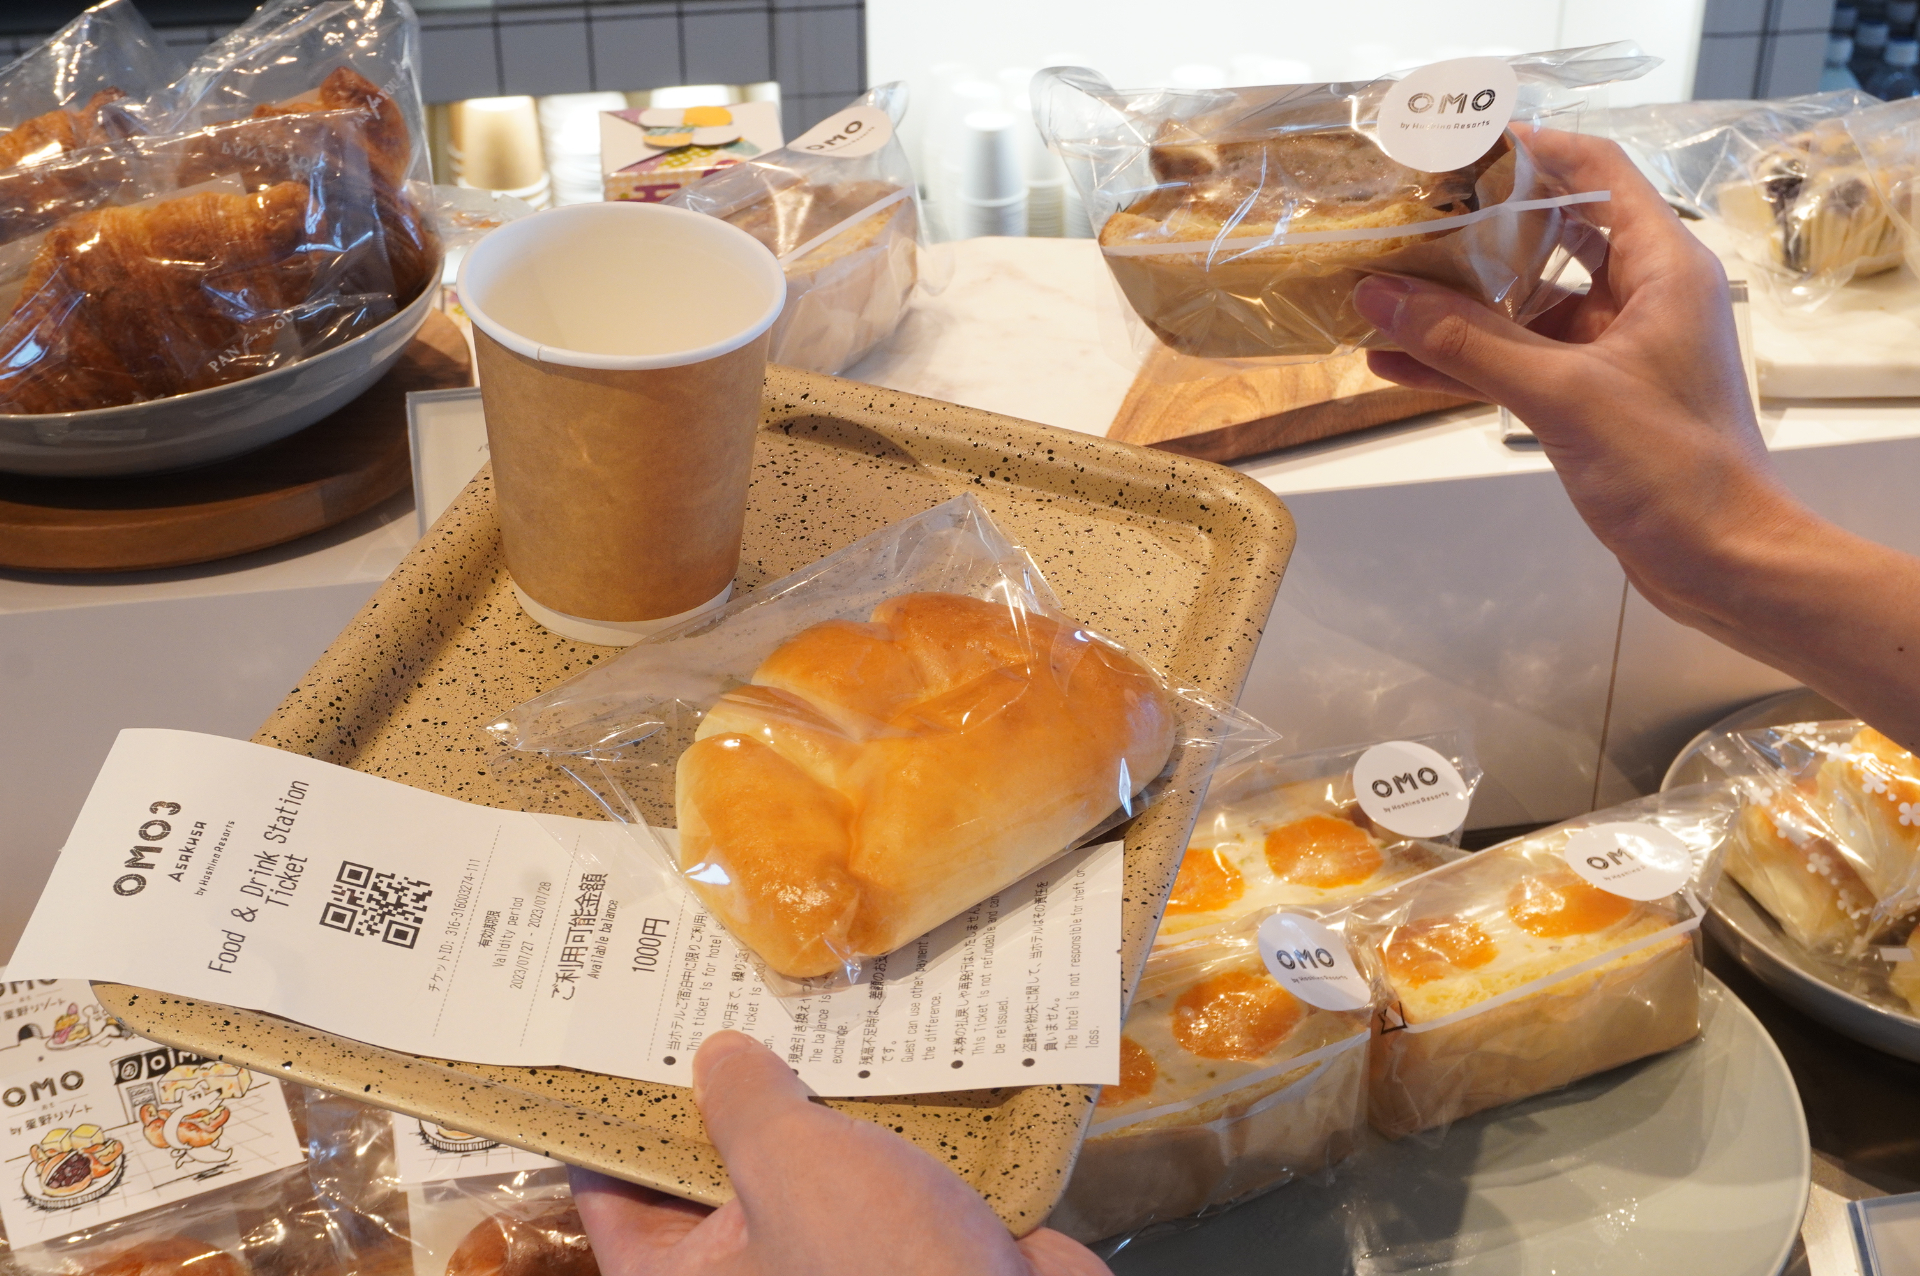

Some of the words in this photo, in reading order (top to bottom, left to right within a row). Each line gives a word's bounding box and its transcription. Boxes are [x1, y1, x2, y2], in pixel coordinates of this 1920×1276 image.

[1407, 89, 1496, 114] OMO
[805, 121, 863, 150] OMO
[1400, 122, 1410, 130] by
[1454, 120, 1490, 130] Resorts
[208, 344, 241, 373] PAN
[1371, 767, 1439, 798] OMO
[263, 780, 309, 844] Station
[1391, 799, 1421, 811] Hoshino
[1421, 791, 1450, 802] Resorts
[113, 800, 181, 896] OMO3
[214, 820, 235, 853] Resorts
[168, 821, 207, 882] Asakusa
[1586, 848, 1635, 870] OM
[199, 853, 220, 887] Hoshino
[239, 851, 280, 898] Drink
[264, 853, 308, 907] Ticket
[1076, 869, 1086, 878] or
[194, 887, 208, 896] by
[1073, 880, 1085, 902] theft
[230, 906, 258, 923] &
[987, 910, 998, 924] and
[1072, 904, 1083, 917] for
[428, 941, 455, 992] チケットID:
[445, 858, 481, 936] 316-316003274-111
[478, 910, 501, 948] 有効期限
[492, 929, 516, 968] Validity
[507, 896, 524, 926] period
[510, 941, 534, 990] 2023/07/27
[527, 881, 552, 928] 2023/07/28
[551, 873, 609, 1000] ご利用可能金額
[208, 929, 246, 974] Food
[587, 936, 609, 979] Available
[598, 899, 618, 934] balance
[632, 917, 670, 972] 1000円
[706, 934, 722, 961] hotel
[980, 926, 996, 969] refundable
[1069, 919, 1082, 968] responsible
[916, 941, 929, 972] payment
[1276, 948, 1334, 970] OMO
[702, 962, 716, 981] for
[980, 973, 992, 987] not
[1070, 972, 1080, 987] not
[699, 980, 713, 993] is
[748, 986, 762, 996] is
[818, 994, 831, 1003] is
[910, 976, 924, 998] other
[977, 989, 989, 1000] is
[1067, 990, 1079, 1001] is
[693, 997, 710, 1027] ticket
[742, 1001, 760, 1031] Ticket
[910, 1002, 920, 1017] use
[925, 992, 942, 1043] difference.
[974, 1003, 989, 1033] Ticket
[994, 996, 1009, 1039] reissued.
[1065, 1005, 1079, 1031] hotel
[811, 1009, 829, 1044] balance
[908, 1020, 918, 1035] can
[1043, 997, 1060, 1052] 負いません。
[1085, 1025, 1099, 1049] loss.
[686, 1032, 703, 1051] This
[832, 1022, 848, 1064] exchange.
[882, 1041, 897, 1063] です。
[901, 1039, 916, 1062] Guest
[922, 1046, 936, 1061] the
[972, 1036, 985, 1057] This
[993, 1043, 1006, 1054] be
[1065, 1035, 1078, 1050] The
[809, 1048, 823, 1062] The
[3, 1071, 84, 1108] OMO
[10, 1126, 22, 1135] by
[25, 1104, 92, 1130] 星野リゾート
